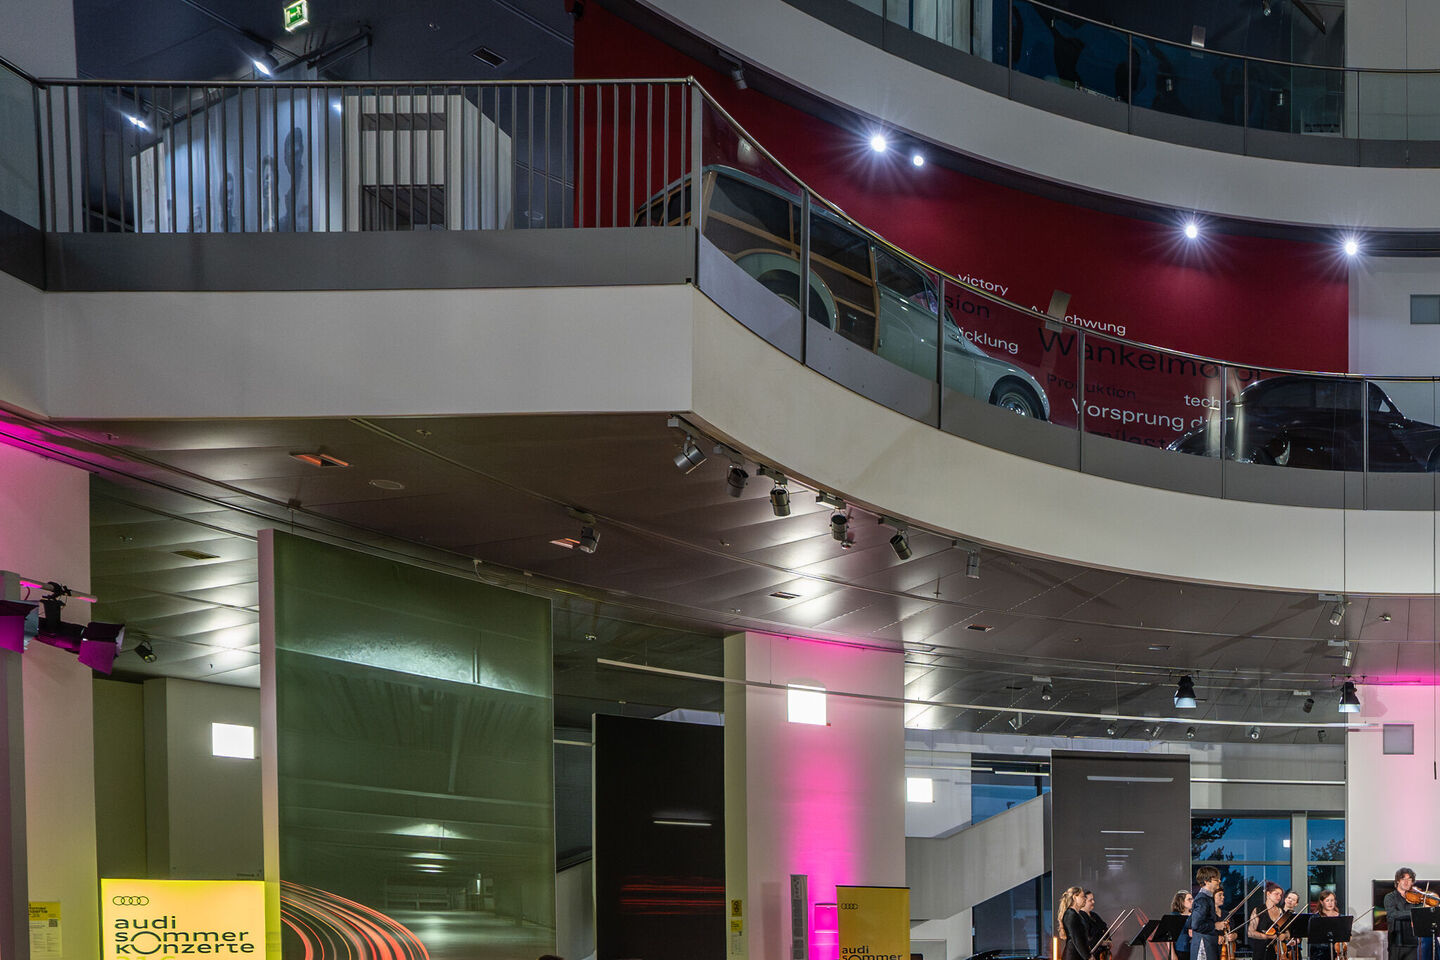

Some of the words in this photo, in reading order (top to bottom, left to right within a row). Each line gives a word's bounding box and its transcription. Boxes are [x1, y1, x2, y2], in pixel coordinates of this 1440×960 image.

[957, 273, 1009, 296] victory
[945, 295, 990, 319] sion
[1031, 305, 1126, 336] Achwung
[960, 327, 1018, 354] icklung
[1038, 327, 1262, 381] Wankelmoor
[1047, 373, 1136, 399] Prouktion
[1071, 397, 1184, 431] Vorsprung
[1184, 394, 1221, 410] tech
[114, 915, 176, 929] audi
[842, 945, 869, 954] audi
